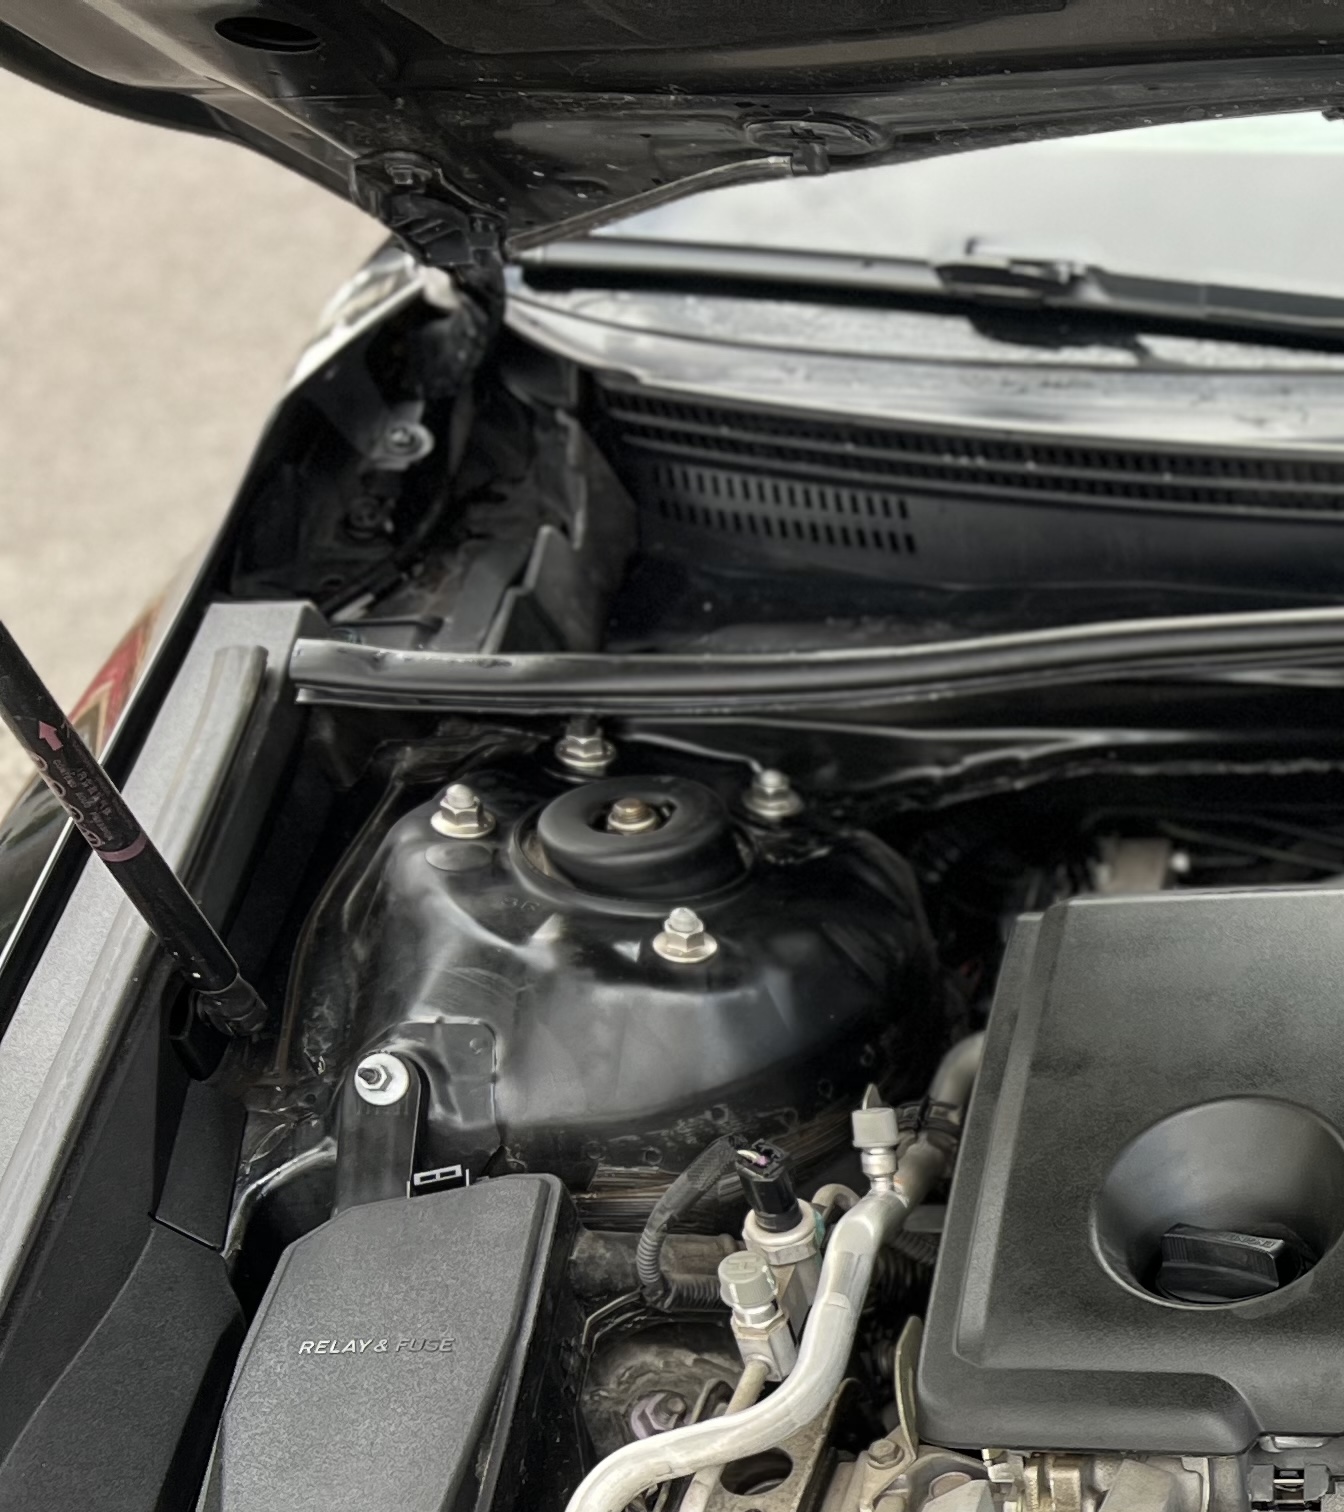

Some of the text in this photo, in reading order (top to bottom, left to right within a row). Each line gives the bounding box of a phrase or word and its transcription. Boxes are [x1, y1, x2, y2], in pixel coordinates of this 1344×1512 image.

[299, 1337, 456, 1355] RELAY & FUSE
